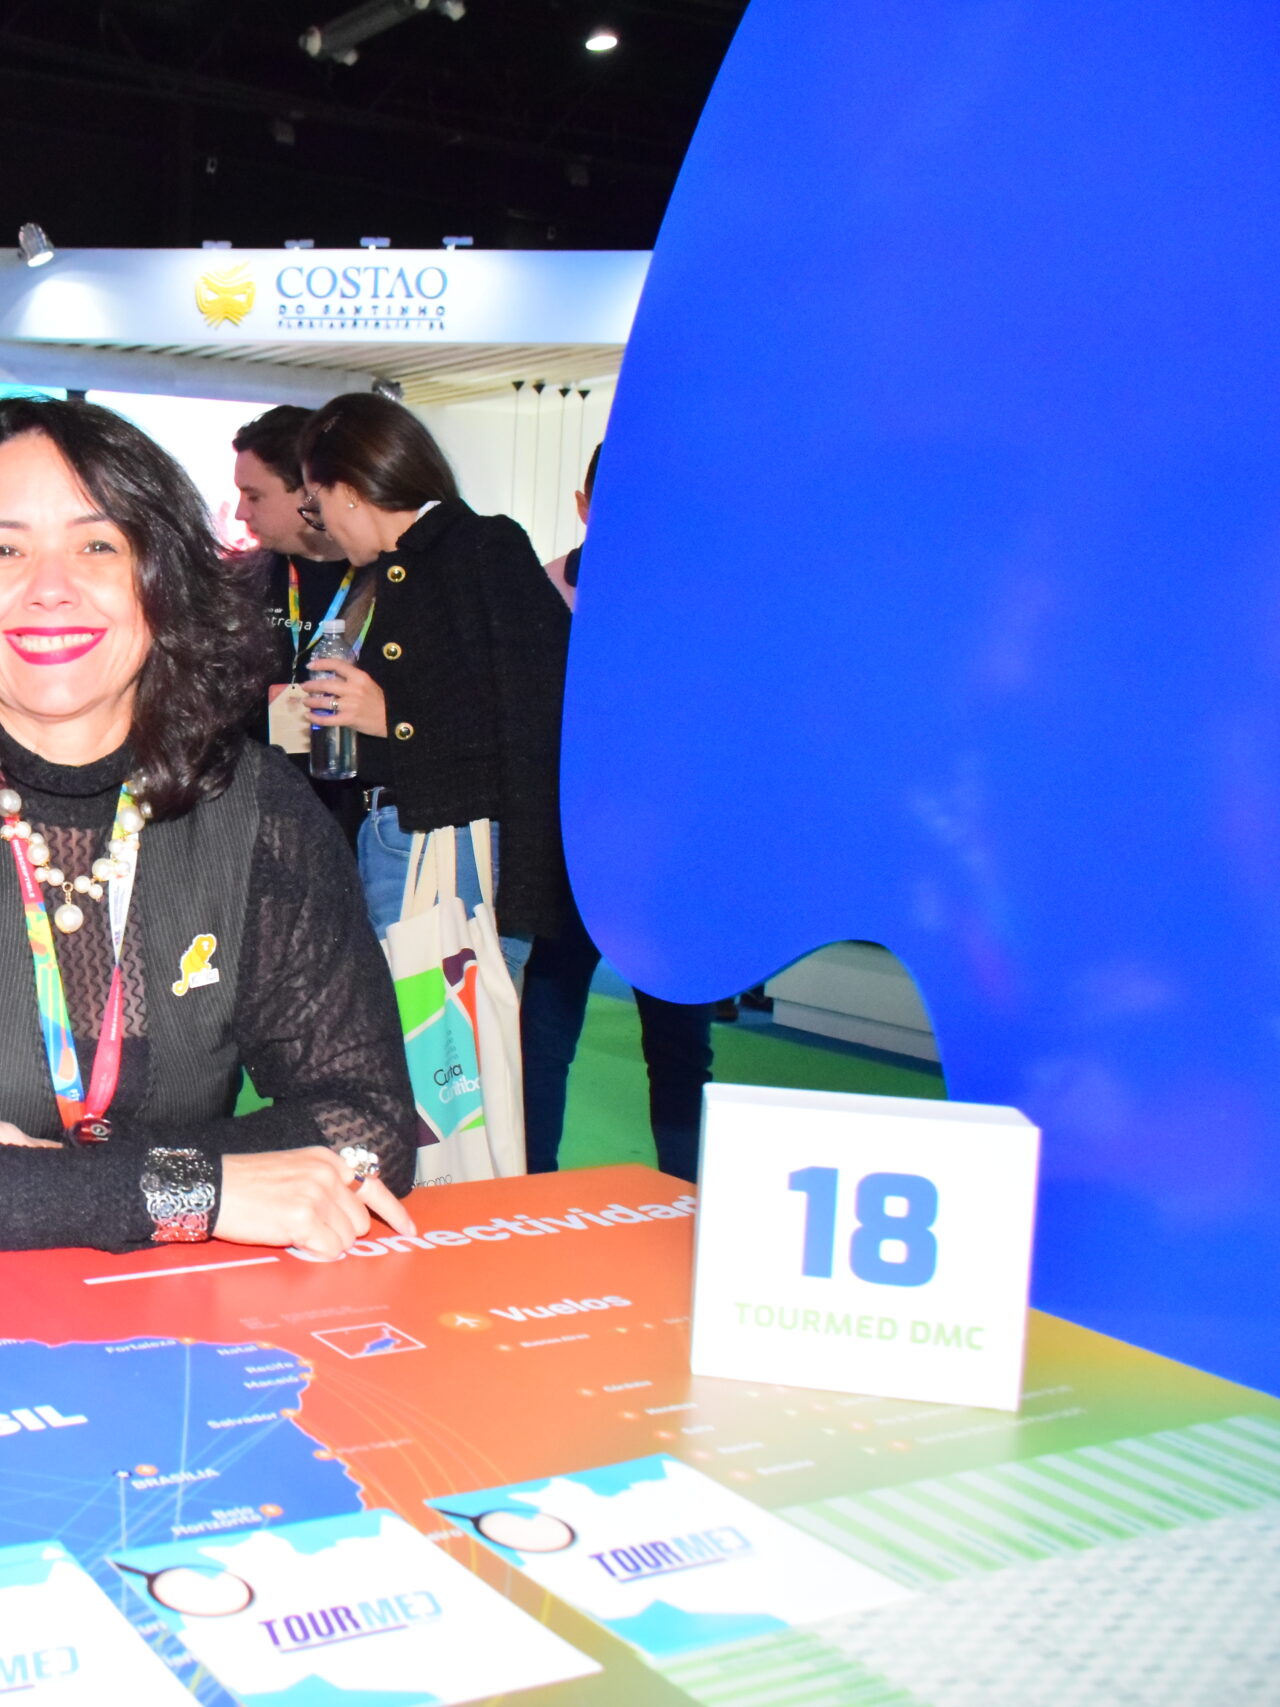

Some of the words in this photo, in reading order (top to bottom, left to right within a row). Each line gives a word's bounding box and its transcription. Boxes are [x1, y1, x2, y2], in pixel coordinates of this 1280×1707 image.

[279, 304, 306, 316] DO
[322, 304, 446, 316] SANTINHO
[788, 1165, 939, 1287] 18
[489, 1295, 633, 1321] Vuelos
[734, 1301, 898, 1341] TOURMED
[909, 1319, 984, 1351] DMC
[207, 1411, 277, 1429] Salvador
